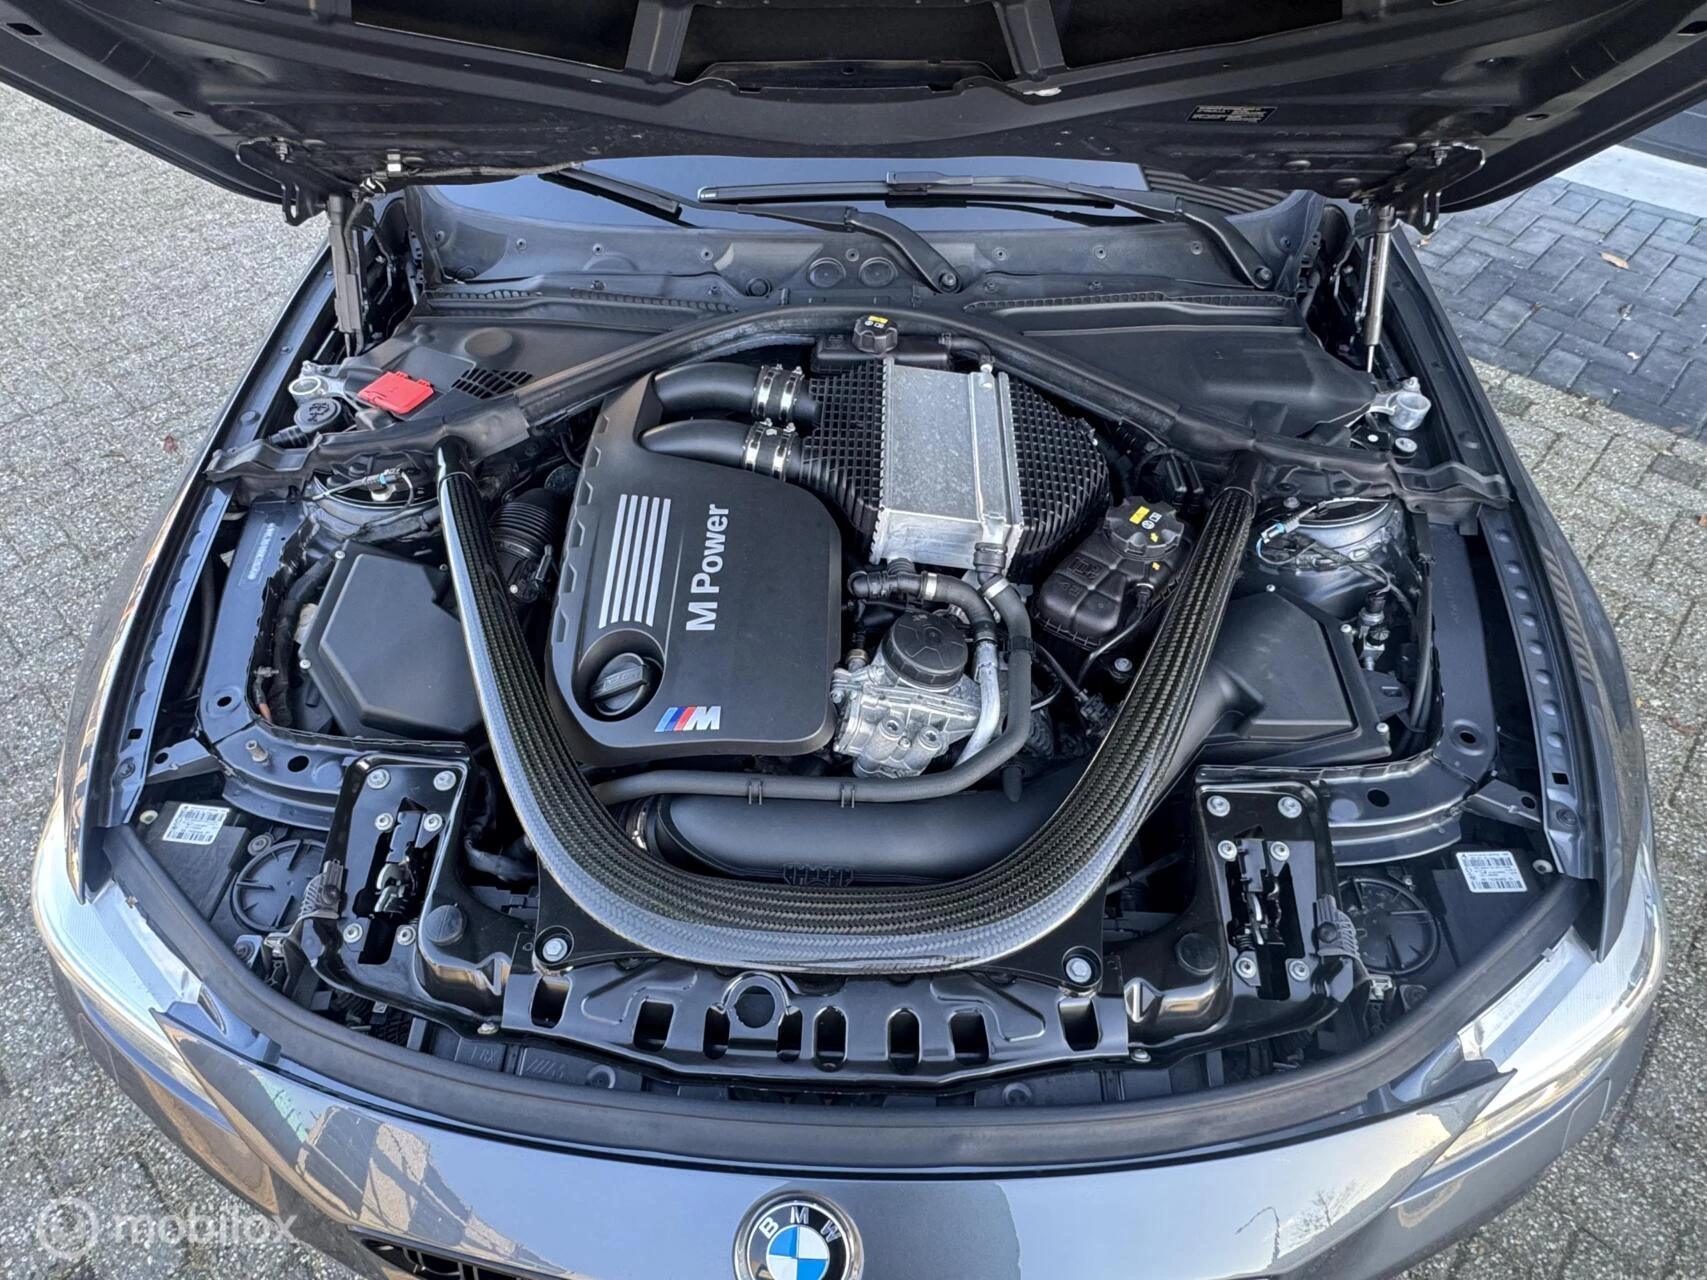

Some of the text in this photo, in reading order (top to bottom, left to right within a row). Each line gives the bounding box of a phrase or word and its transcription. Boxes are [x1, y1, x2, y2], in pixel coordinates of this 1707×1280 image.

[686, 503, 729, 631] M Power
[682, 705, 722, 731] M
[758, 1206, 842, 1243] BMW
